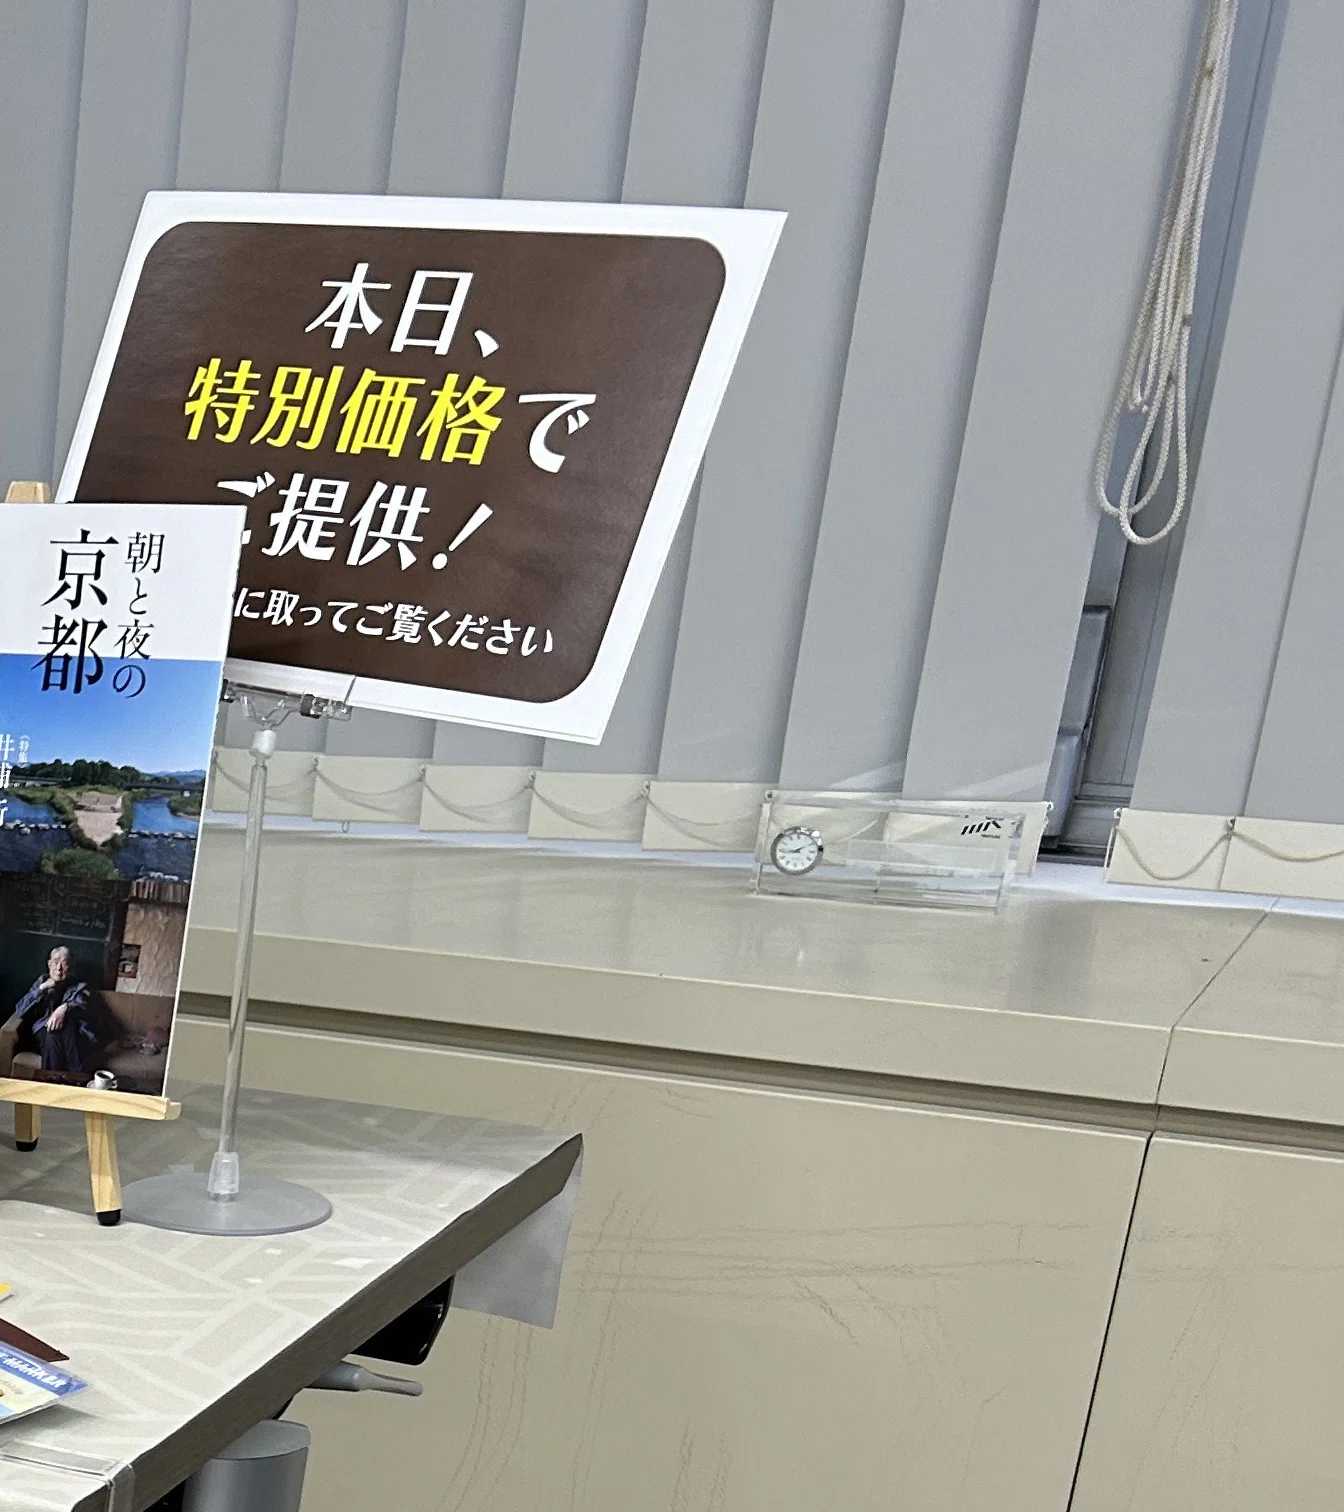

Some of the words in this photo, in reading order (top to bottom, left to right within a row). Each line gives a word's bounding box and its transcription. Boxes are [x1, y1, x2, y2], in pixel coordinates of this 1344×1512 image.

[305, 262, 502, 357] 本日、
[183, 357, 597, 475] 特別価格で
[30, 529, 119, 695] 京都
[112, 531, 166, 699] 朝と夜の
